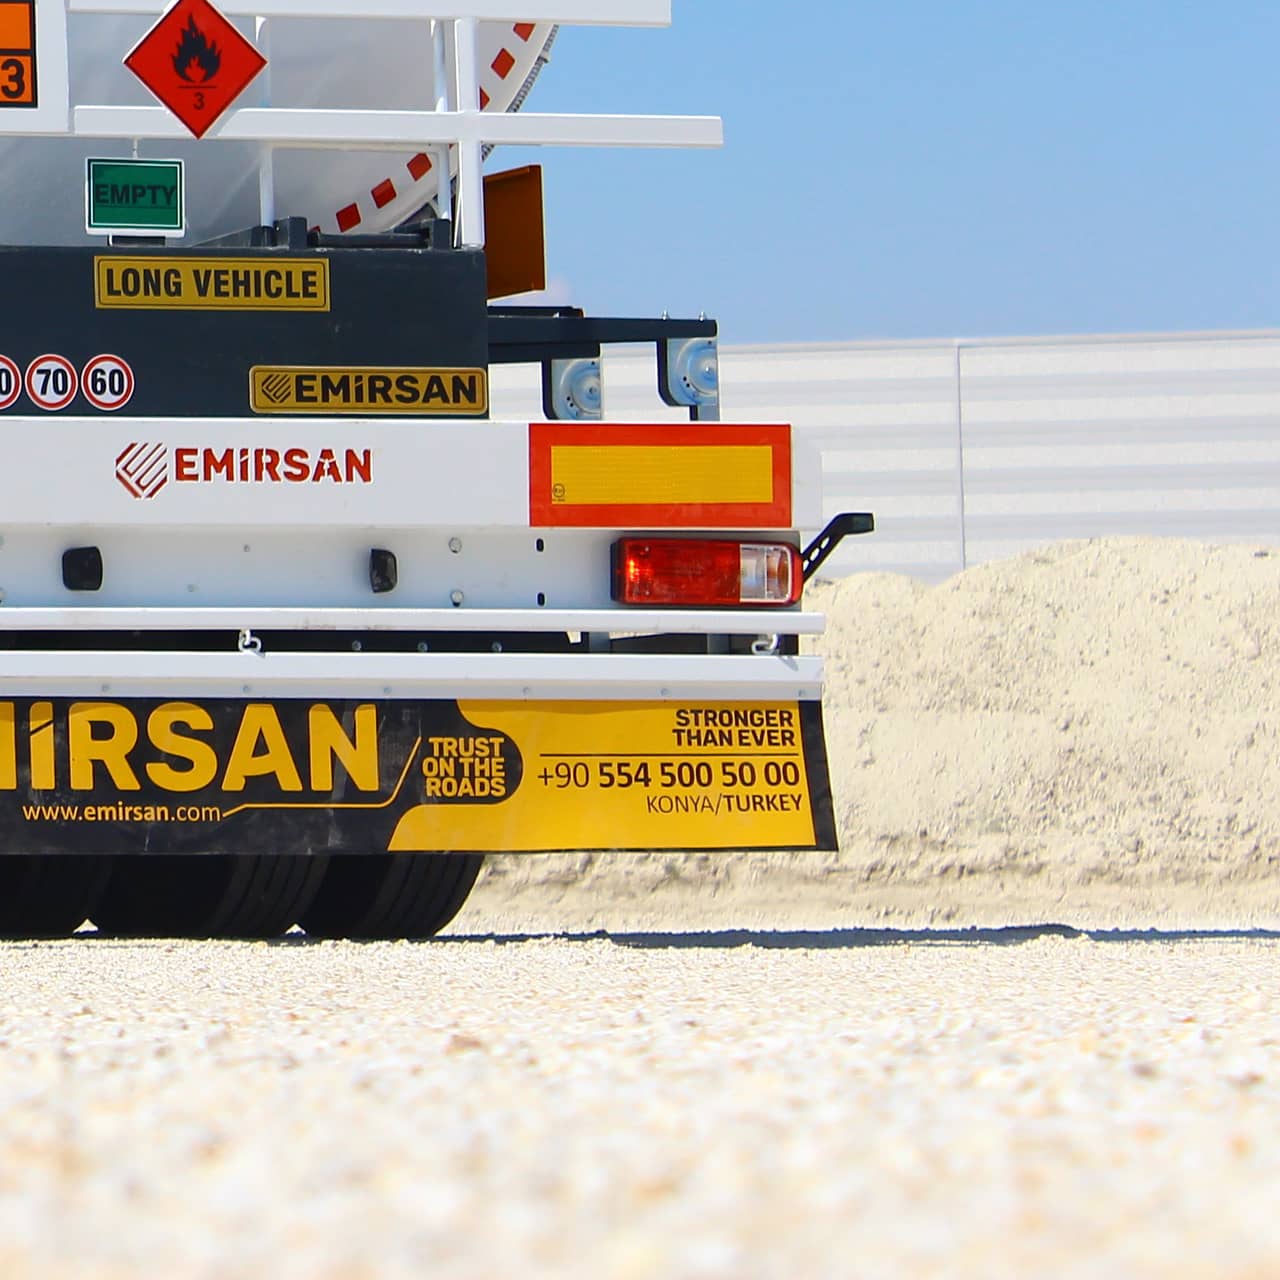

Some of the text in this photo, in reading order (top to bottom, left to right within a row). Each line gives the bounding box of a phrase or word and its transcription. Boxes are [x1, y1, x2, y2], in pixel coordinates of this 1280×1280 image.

[193, 92, 205, 110] 3
[94, 183, 177, 206] EMPTY
[106, 267, 318, 300] LONG VEHICLE
[36, 368, 69, 396] 70
[90, 368, 125, 396] 60
[676, 709, 794, 728] STRONGER
[429, 737, 505, 758] TRUST
[672, 728, 795, 747] THAN EVER
[422, 756, 505, 778] ON THE
[538, 761, 800, 788] +90 554 500 50 00
[426, 776, 506, 797] ROADS
[22, 803, 221, 823] www.emirsan.com
[647, 793, 803, 815] KONYA/TURKEY
